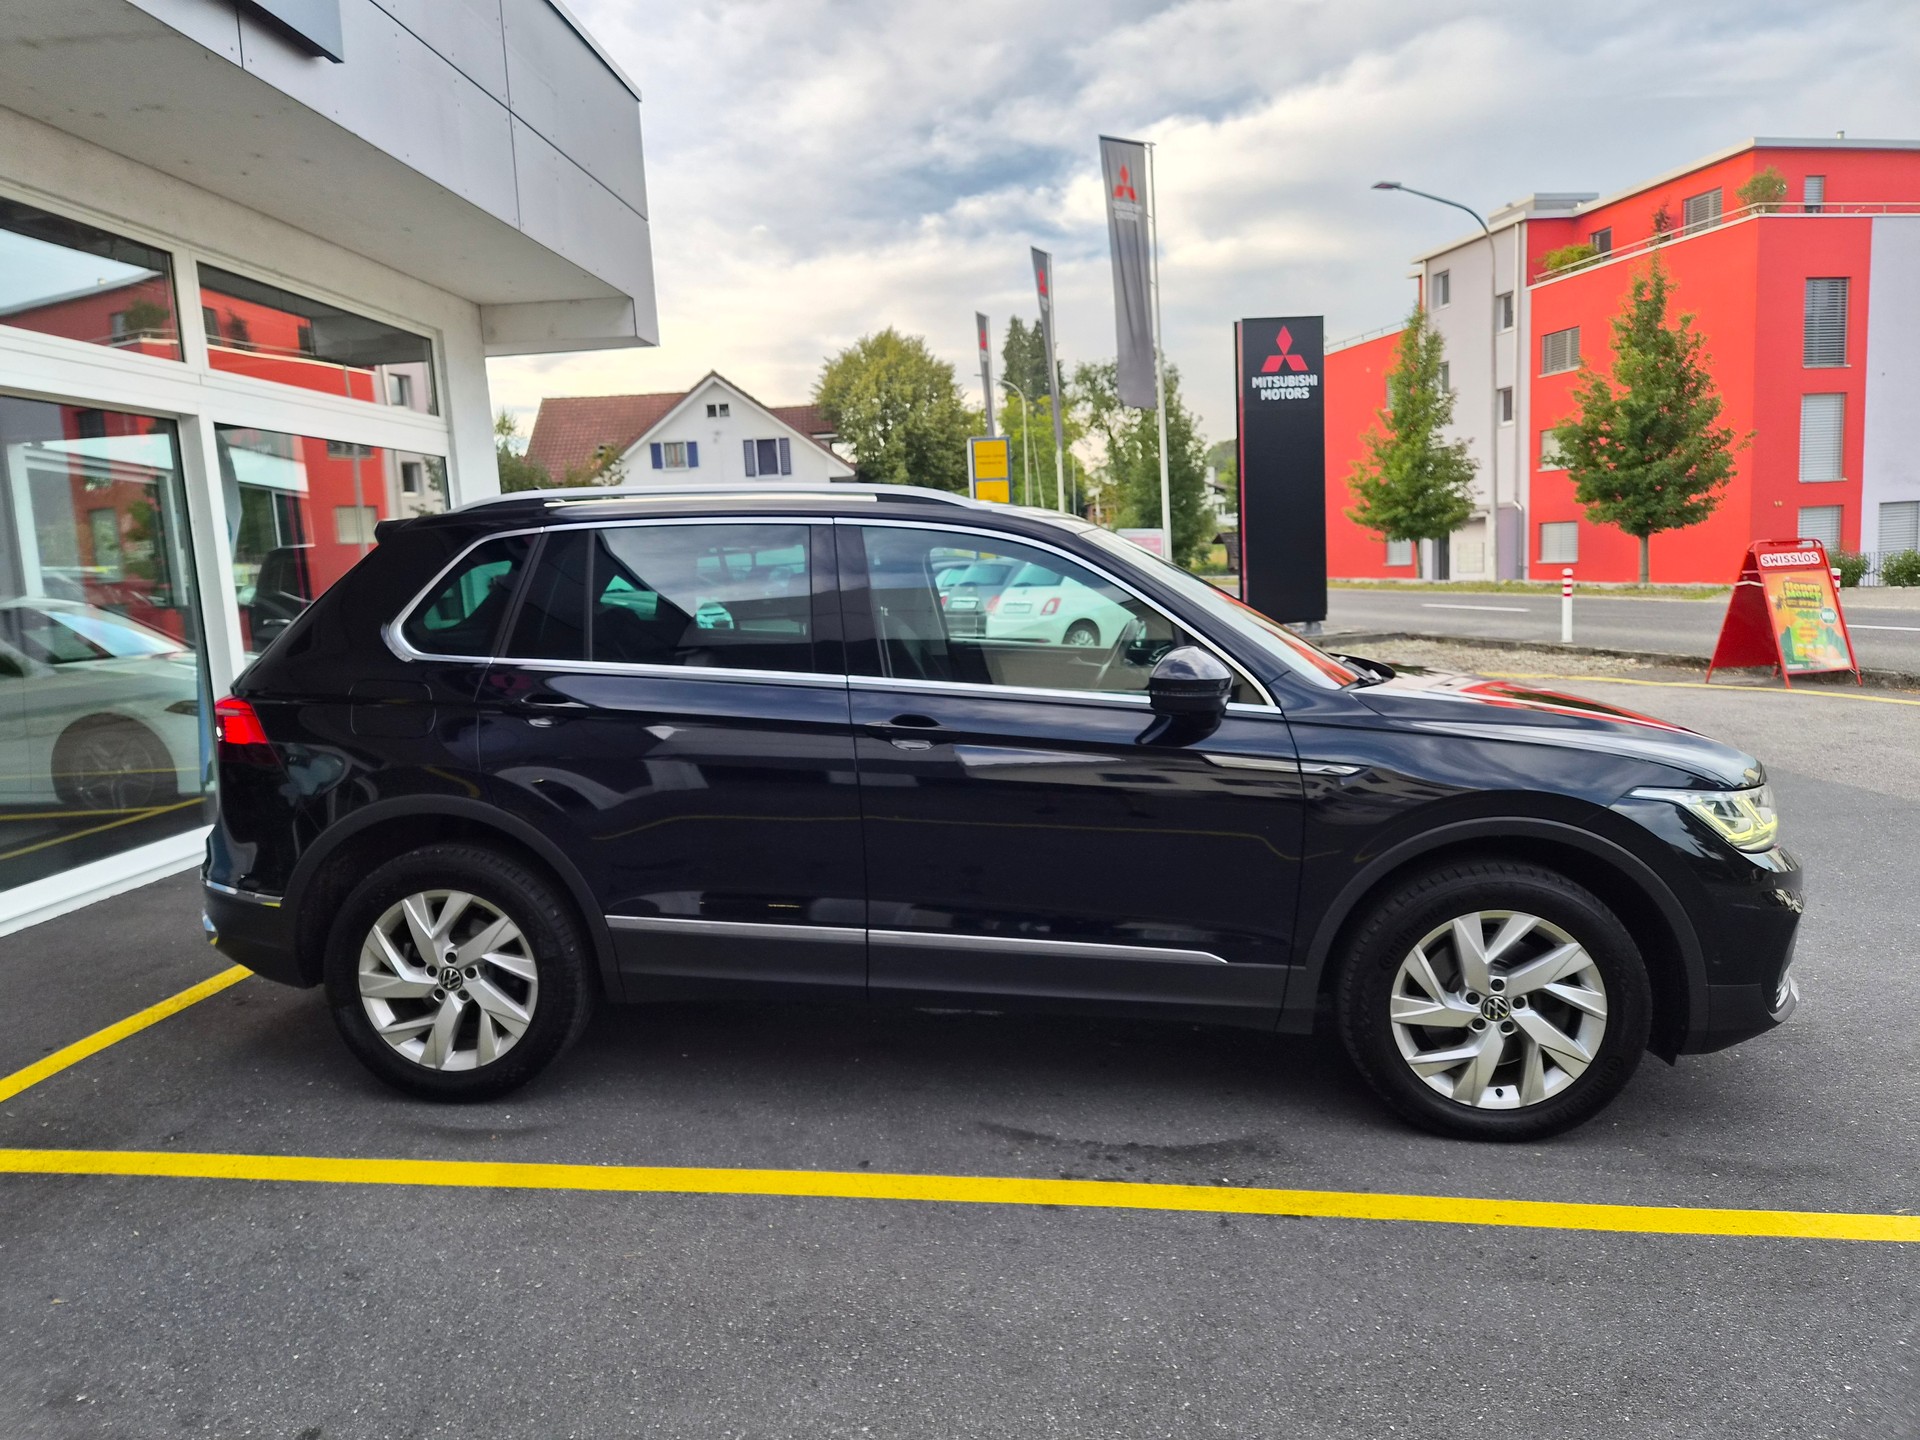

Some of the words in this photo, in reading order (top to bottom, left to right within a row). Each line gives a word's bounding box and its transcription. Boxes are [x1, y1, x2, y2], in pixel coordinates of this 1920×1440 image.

[1251, 374, 1318, 388] MITSUBISHI
[1260, 387, 1310, 400] MOTORS
[1762, 553, 1818, 565] SWISSLOS
